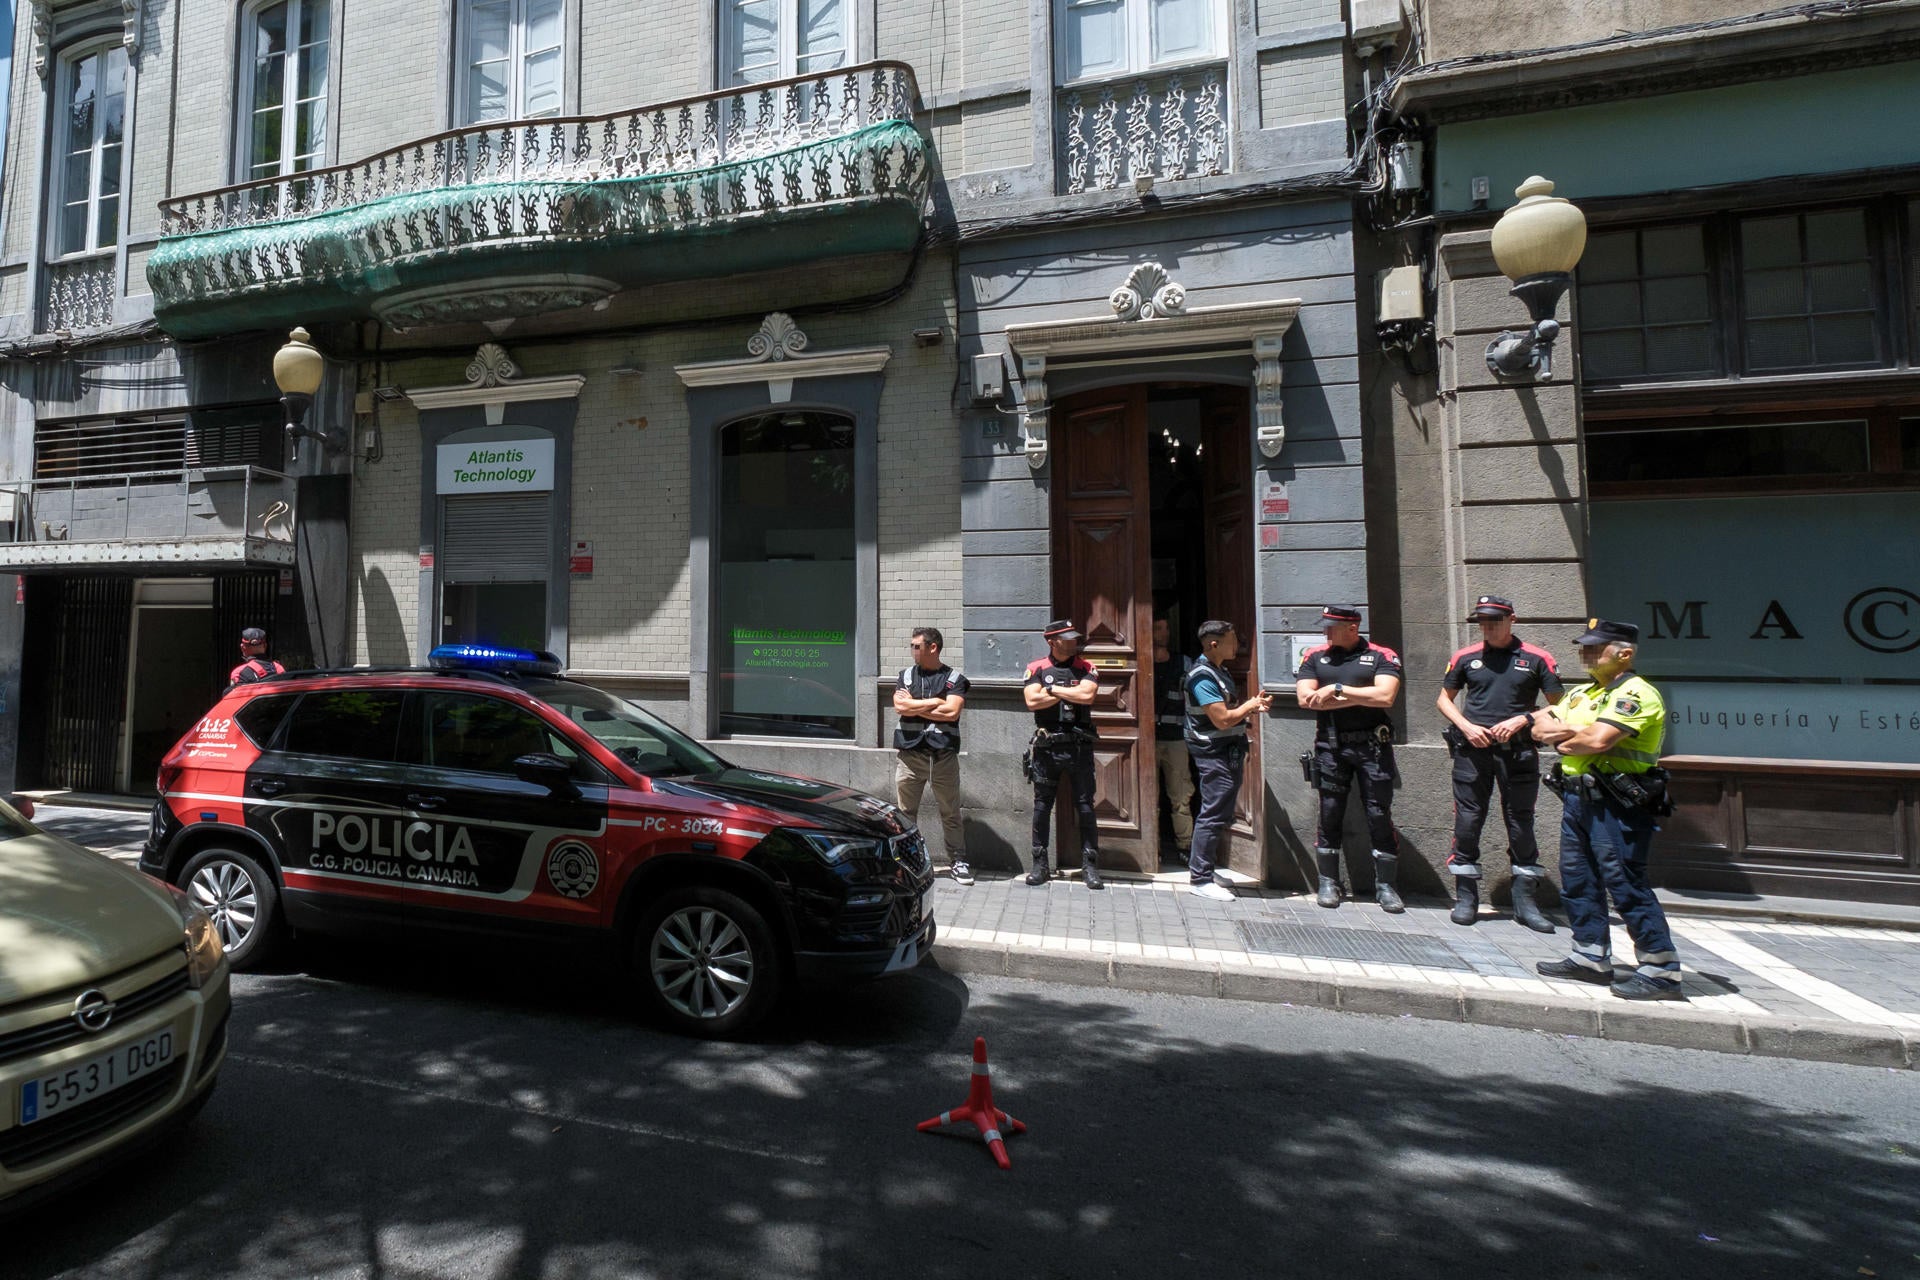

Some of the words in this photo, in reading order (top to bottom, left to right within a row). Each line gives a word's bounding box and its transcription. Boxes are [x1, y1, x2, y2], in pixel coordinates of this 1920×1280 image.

[467, 449, 524, 464] Atlantis
[453, 467, 537, 482] Technology
[729, 628, 774, 639] Atlantis
[777, 628, 847, 641] Technology
[762, 648, 779, 657] 928
[808, 648, 820, 658] 25
[1671, 705, 1809, 730] eluquería
[1828, 713, 1840, 732] y
[643, 816, 666, 832] PC
[681, 818, 723, 836] 3034
[312, 811, 480, 866] POLICIA
[309, 852, 339, 871] C.G.
[342, 855, 402, 879] POLICIA
[406, 864, 480, 887] CANARIA
[43, 1055, 115, 1110] 5531
[127, 1032, 172, 1077] DGD
